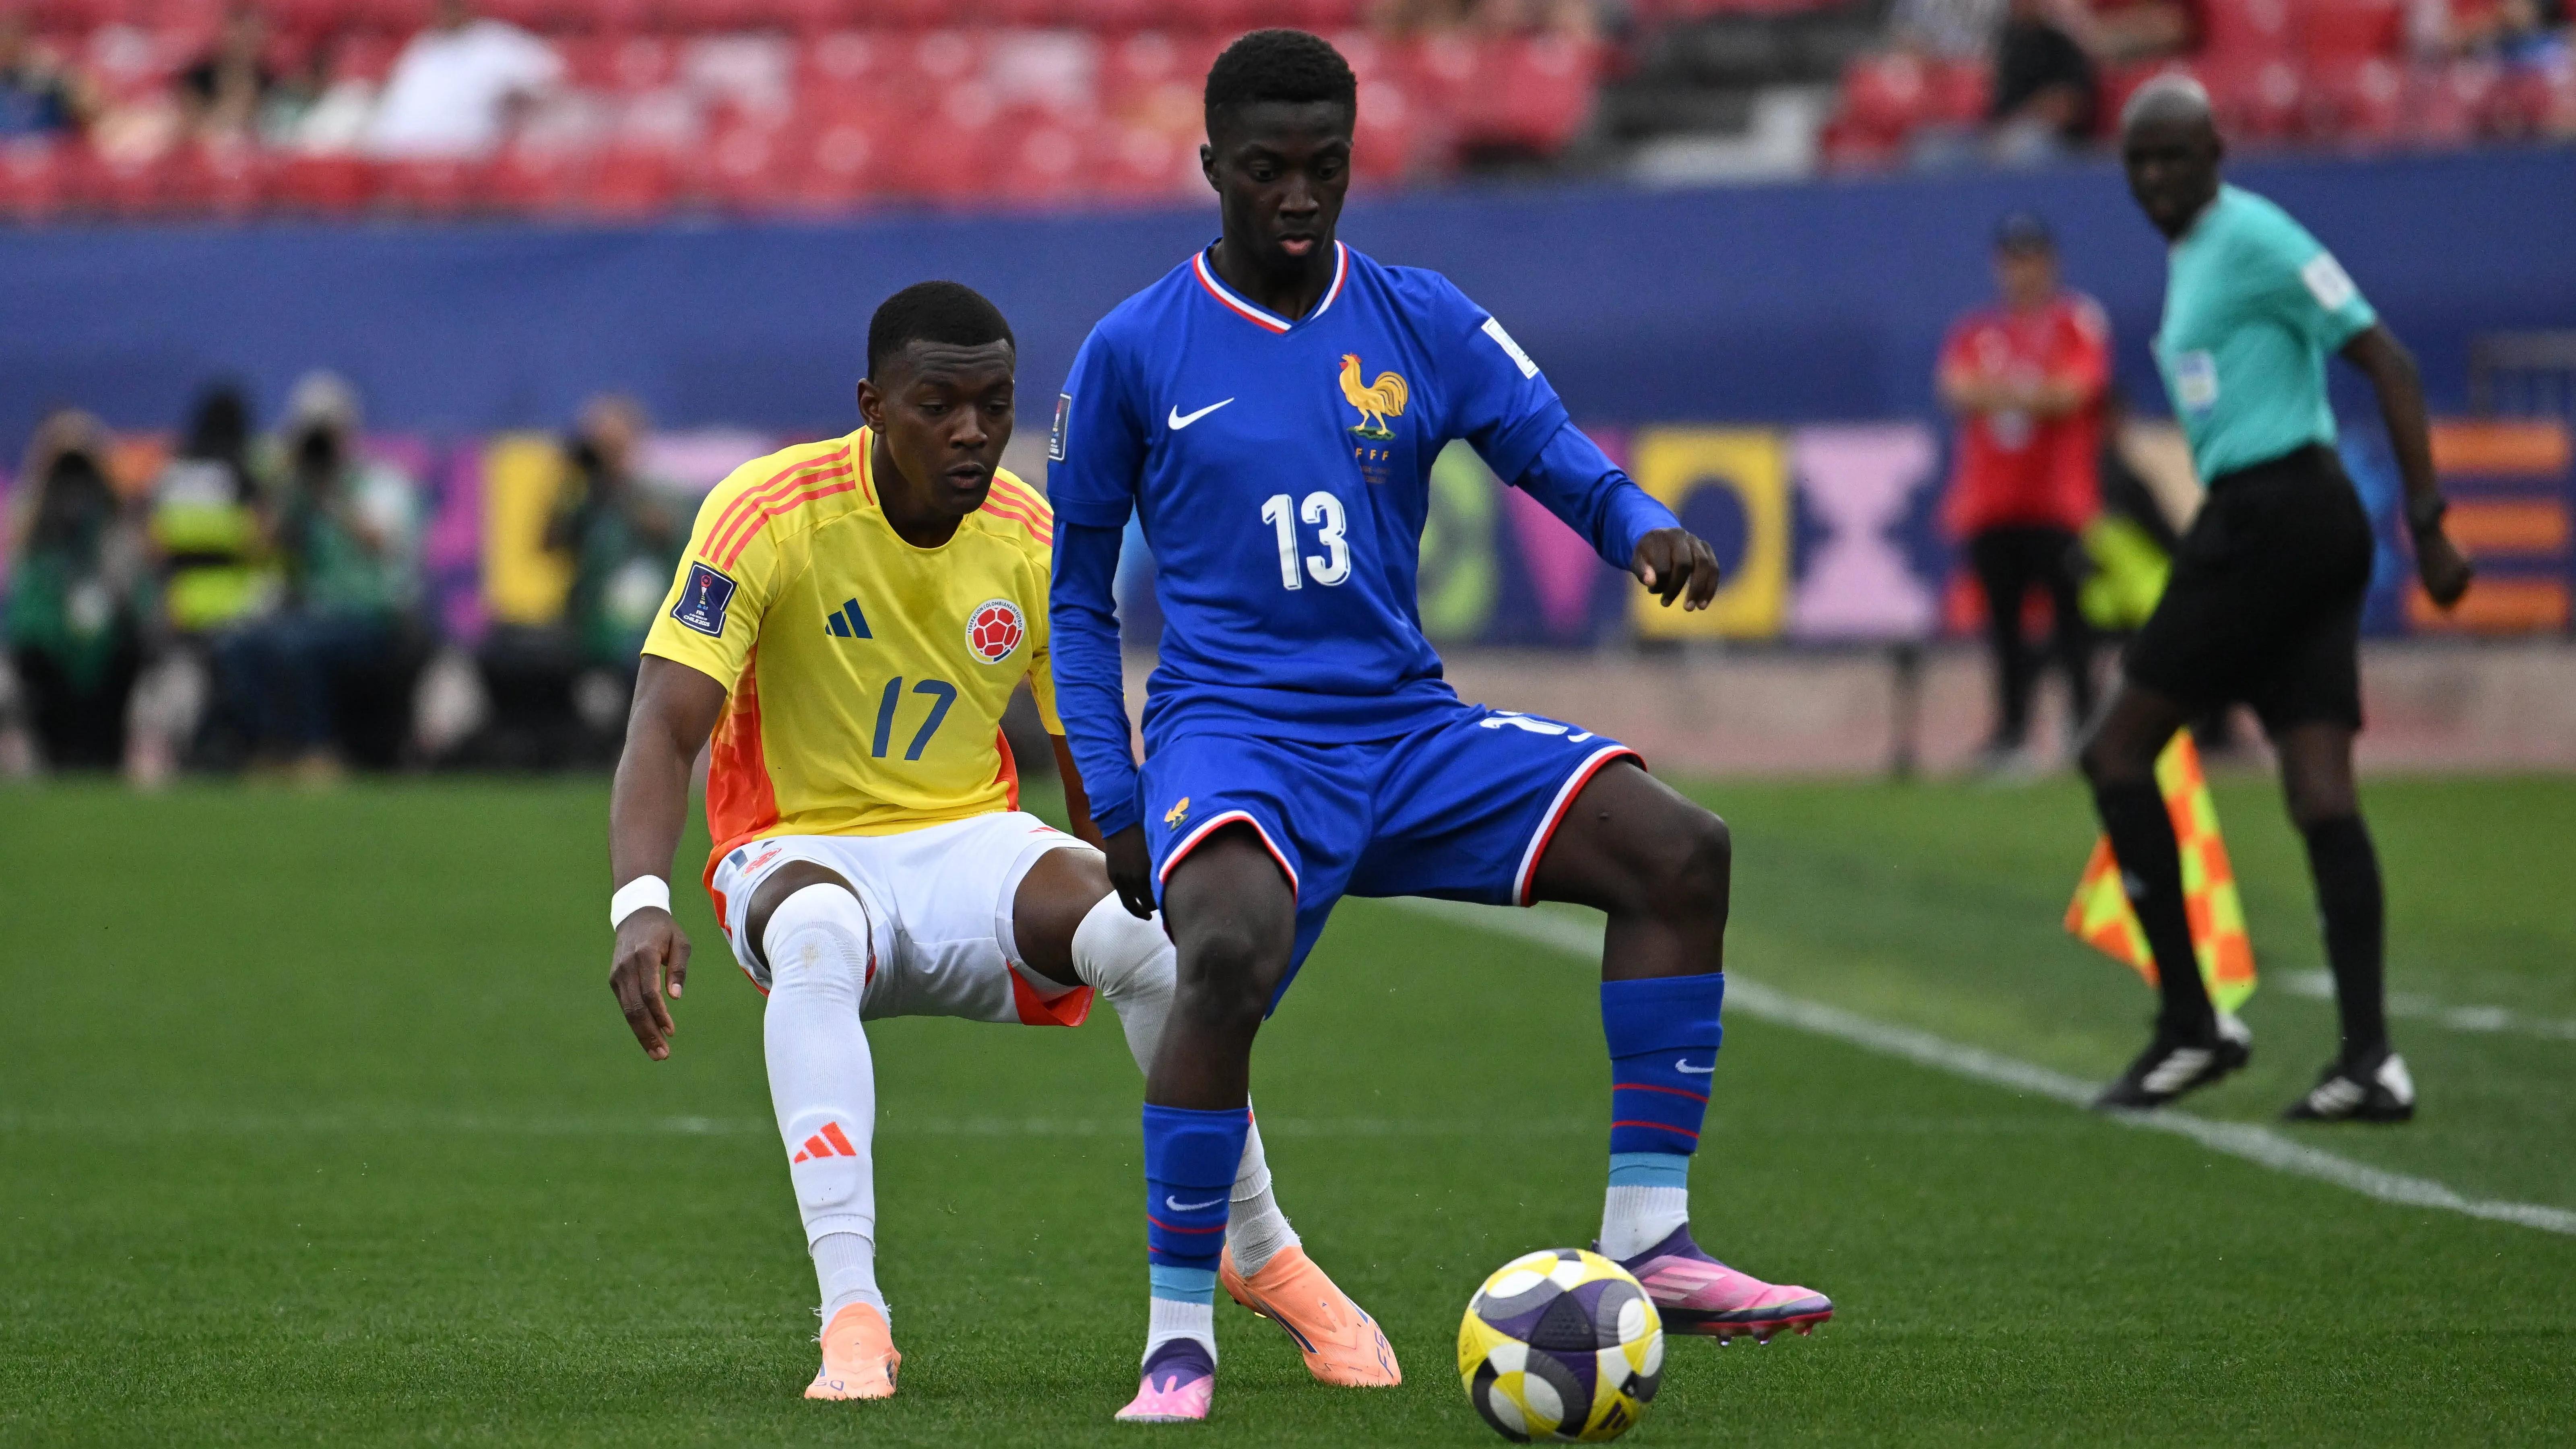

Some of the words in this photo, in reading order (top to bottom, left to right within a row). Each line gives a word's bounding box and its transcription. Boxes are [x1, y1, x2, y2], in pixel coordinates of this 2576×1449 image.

[1261, 491, 1351, 590] 13
[983, 601, 1012, 610] COLOMBIANA
[871, 676, 958, 761] 17
